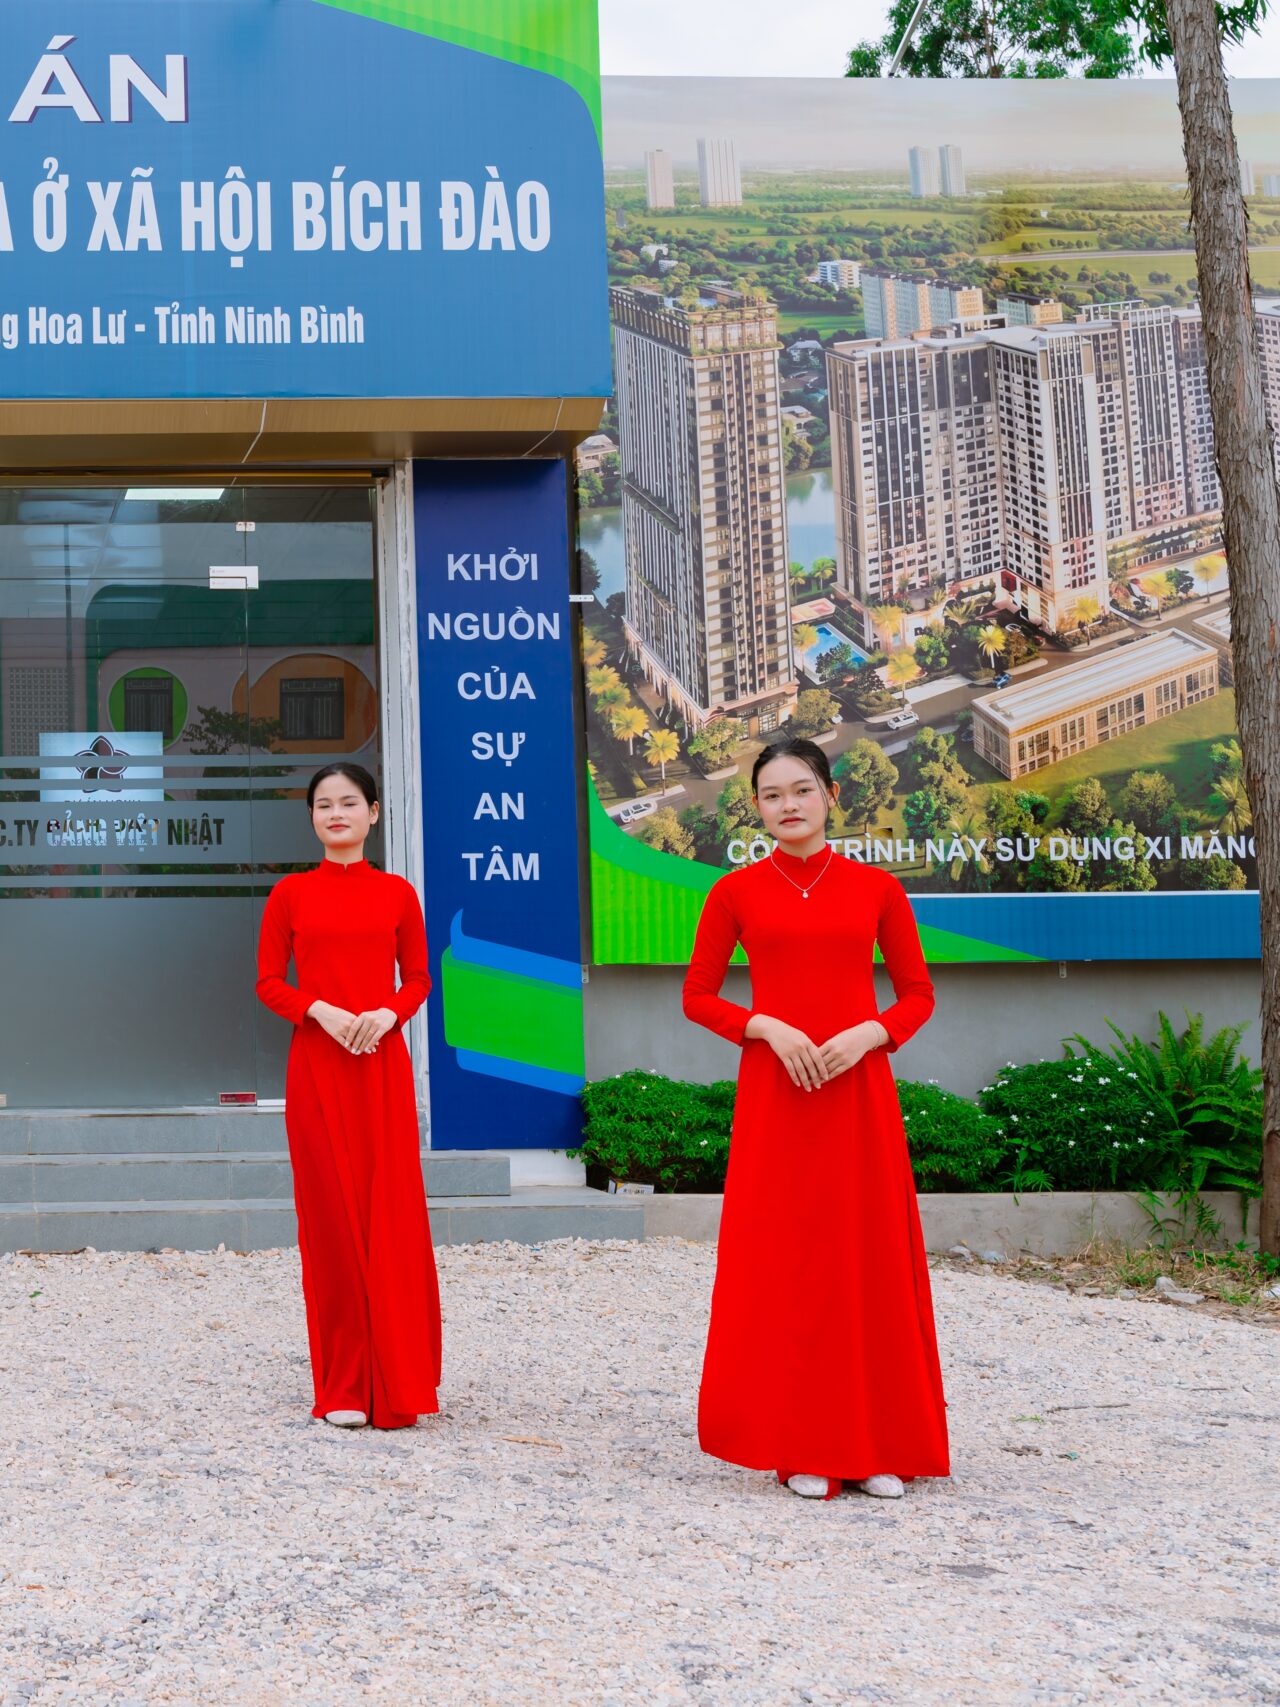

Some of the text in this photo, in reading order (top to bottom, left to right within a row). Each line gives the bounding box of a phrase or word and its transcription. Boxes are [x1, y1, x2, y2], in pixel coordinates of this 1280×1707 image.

[7, 35, 188, 123] ÁN
[32, 156, 69, 253] Ở
[86, 166, 163, 252] XÃ
[180, 165, 272, 268] HỘI
[292, 165, 422, 252] BÍCH
[438, 165, 552, 252] ĐÀO
[28, 306, 83, 345] Hoa
[92, 306, 127, 345] Lư
[154, 301, 216, 344] Tỉnh
[225, 306, 291, 344] Ninh
[300, 305, 365, 344] Bình
[446, 546, 538, 581] KHỞI
[427, 606, 561, 641] NGUỒN
[456, 665, 537, 700] CỦA
[471, 732, 526, 767] SỰ
[472, 792, 525, 820] AN
[166, 812, 225, 852] NHẬT
[726, 833, 779, 865] CÔ
[831, 832, 917, 863] TRÌNH
[925, 832, 988, 862] NÀY
[995, 831, 1041, 862] SỬ
[1048, 835, 1136, 867] DỤNG
[1143, 836, 1171, 860] XI
[461, 845, 540, 881] TÂM
